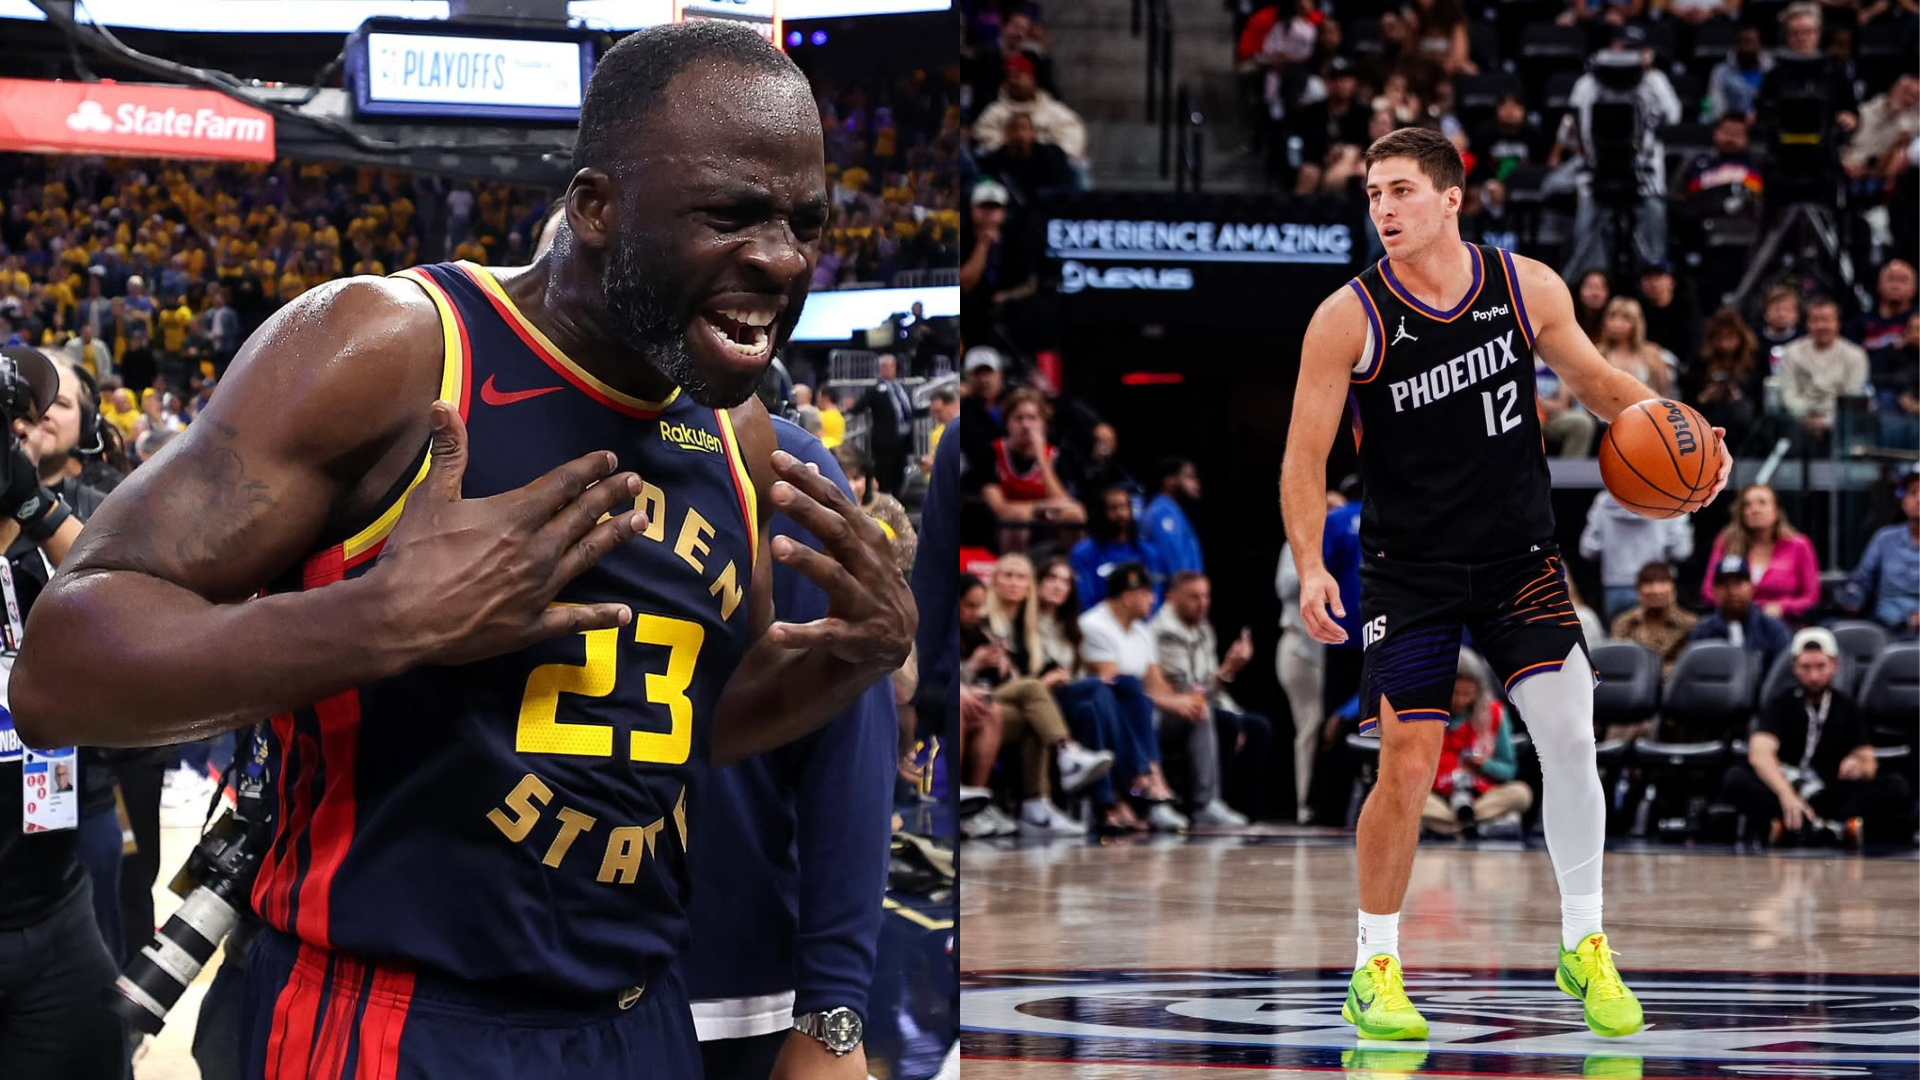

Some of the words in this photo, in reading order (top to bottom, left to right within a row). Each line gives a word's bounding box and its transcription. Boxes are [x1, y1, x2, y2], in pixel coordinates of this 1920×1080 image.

[403, 49, 506, 90] PLAYOFFS
[1048, 219, 1215, 251] EXPERIENCE
[1216, 223, 1352, 254] AMAZING
[1086, 267, 1194, 290] LEXUS
[1472, 304, 1509, 321] PayPal
[1388, 328, 1518, 412] PHOENIX
[1481, 380, 1522, 437] 12
[660, 421, 724, 454] Rakuten
[597, 481, 743, 622] DEN
[1362, 615, 1387, 652] NS
[516, 602, 705, 764] 23
